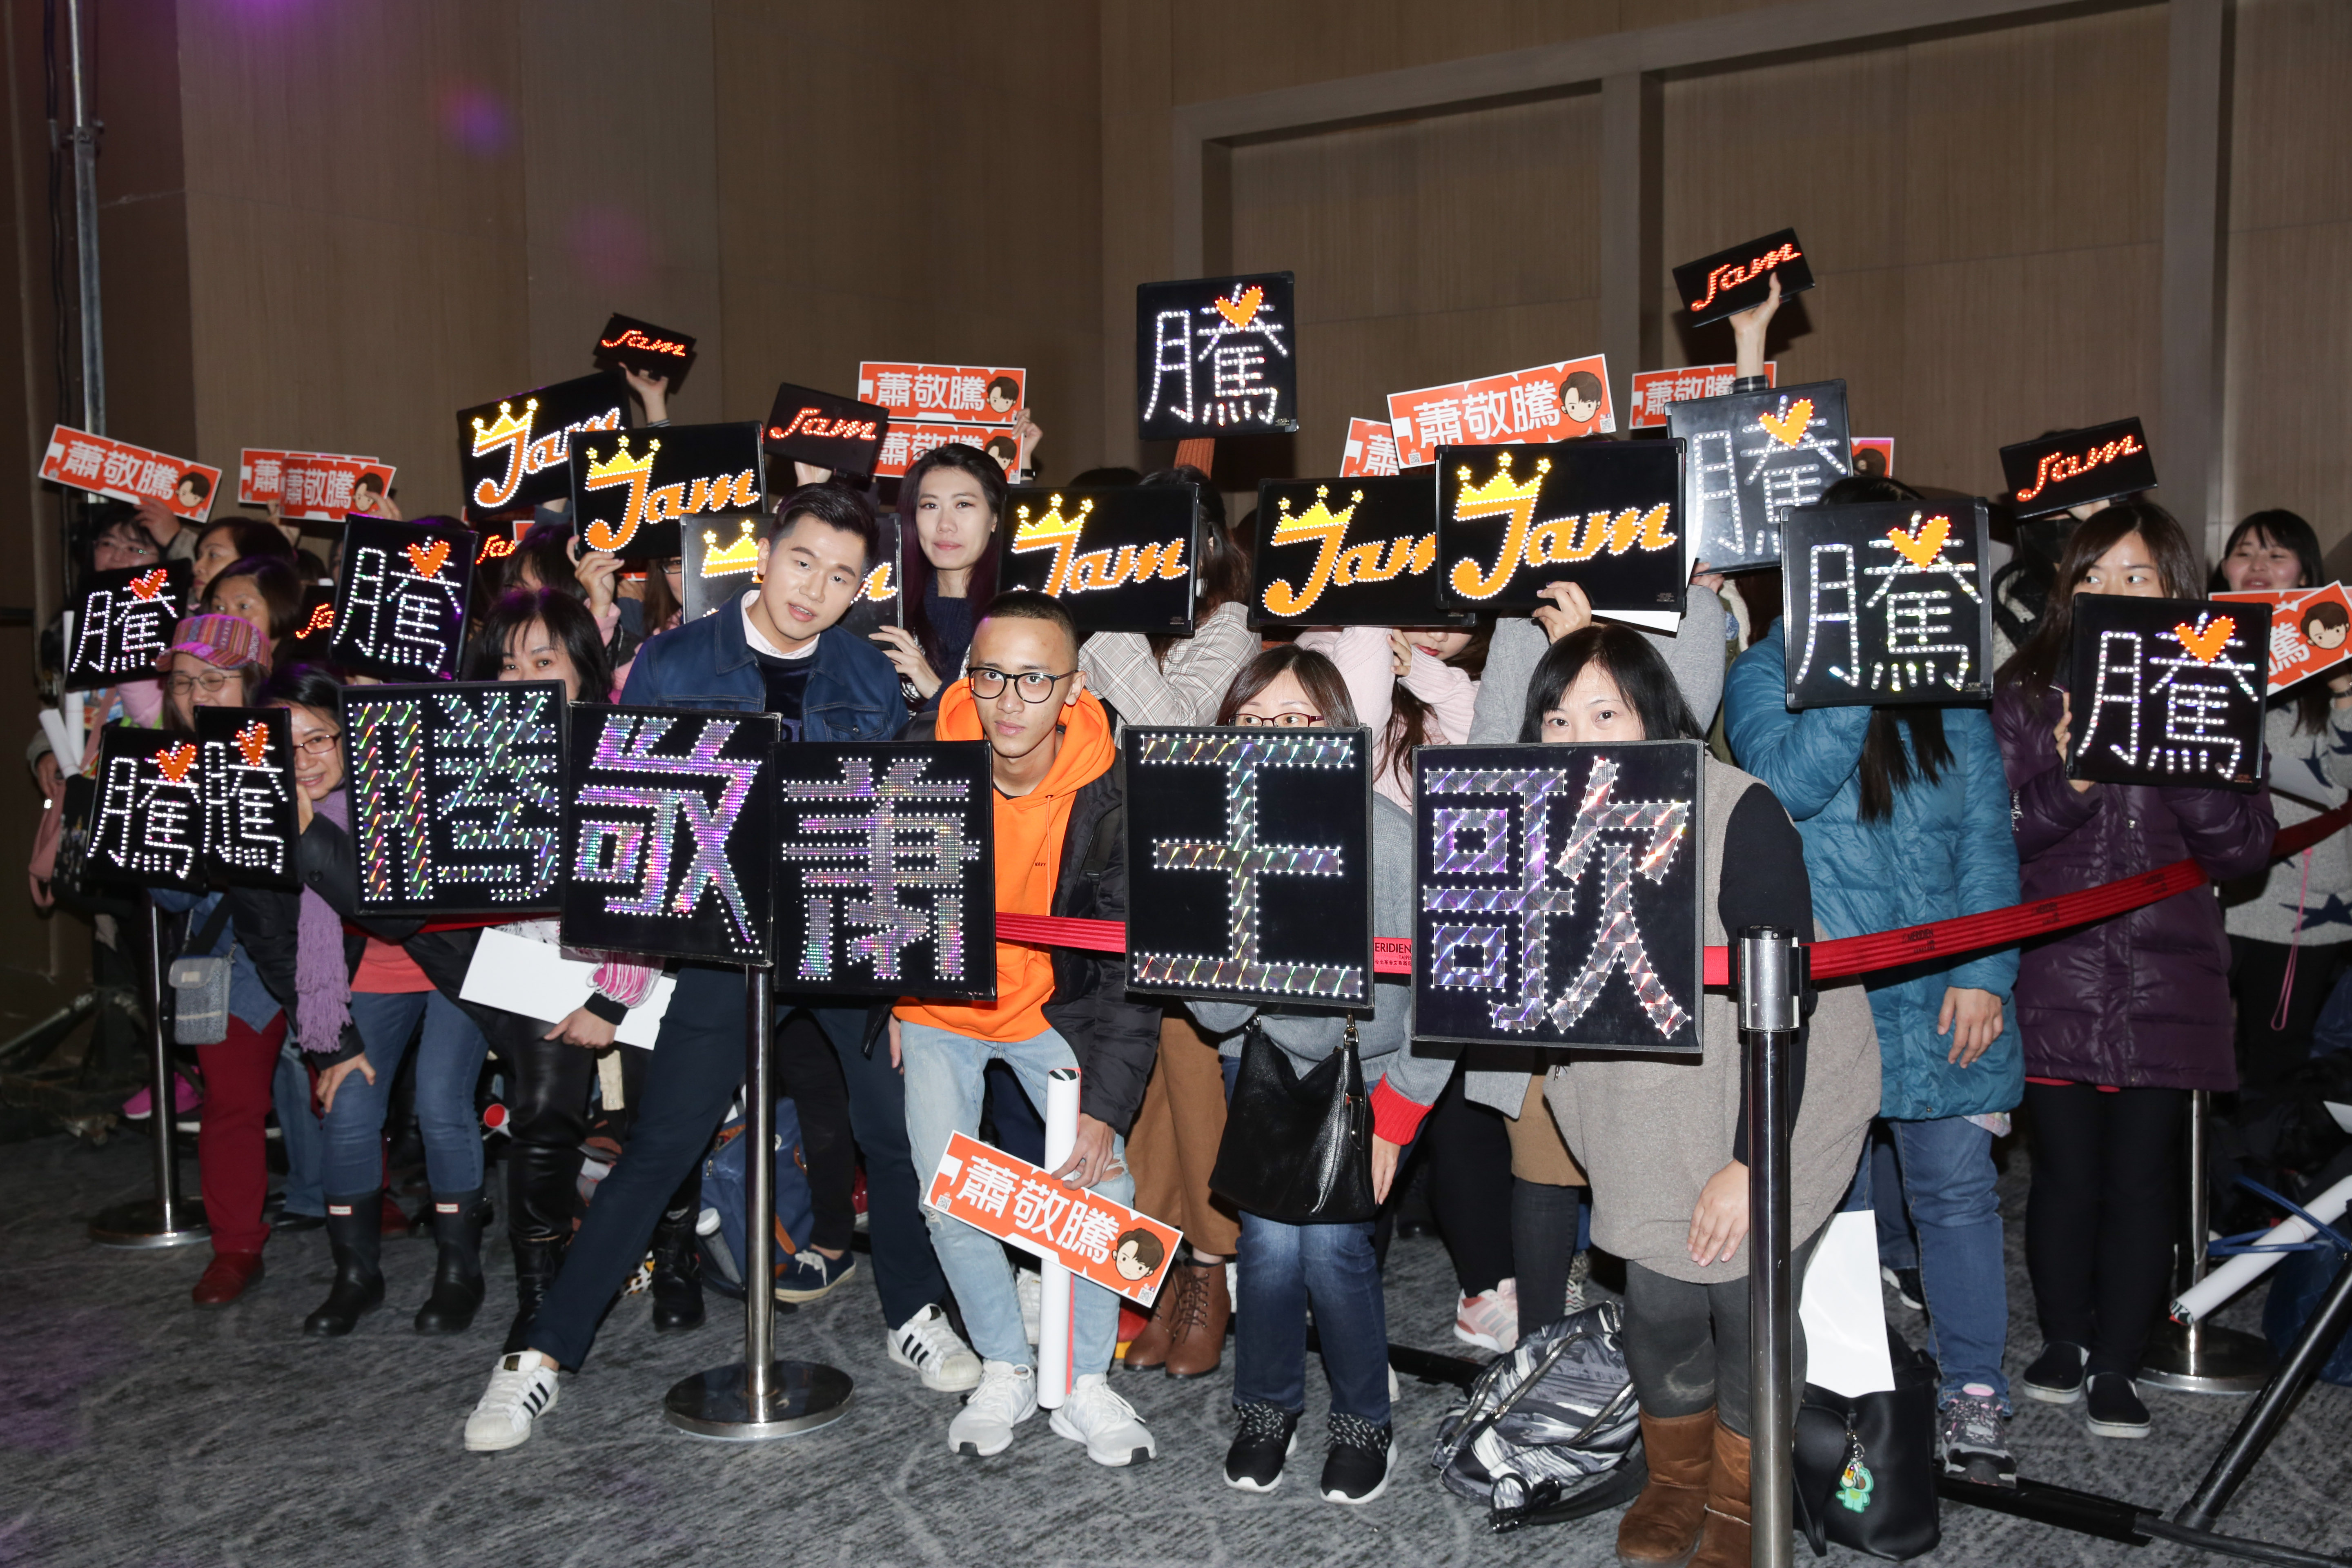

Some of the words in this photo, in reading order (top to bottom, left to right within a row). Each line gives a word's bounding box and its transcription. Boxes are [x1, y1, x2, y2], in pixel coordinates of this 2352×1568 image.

[1690, 243, 1802, 312] Jam
[601, 330, 686, 357] Jam
[1143, 283, 1289, 426] 騰
[769, 408, 878, 441] Jam
[876, 372, 986, 411] 蕭敬騰
[1413, 379, 1561, 449] 蕭敬騰
[62, 440, 178, 501] 蕭敬騰
[286, 467, 356, 509] 蕭敬騰
[2016, 434, 2143, 502] Jam
[584, 469, 761, 552] Jam
[1450, 496, 1678, 600] Jam
[1011, 530, 1190, 598] Jam
[1794, 510, 1983, 691] 騰
[295, 603, 335, 639] Ja
[333, 535, 462, 674] 騰
[2076, 609, 2259, 780] 騰
[86, 739, 202, 880] 騰
[203, 719, 289, 875] 騰
[1134, 734, 1362, 998] 王
[1423, 755, 1693, 1040] 歌
[1375, 942, 1412, 953] ERIDIEN
[956, 1155, 1120, 1265] 蕭敬騰
